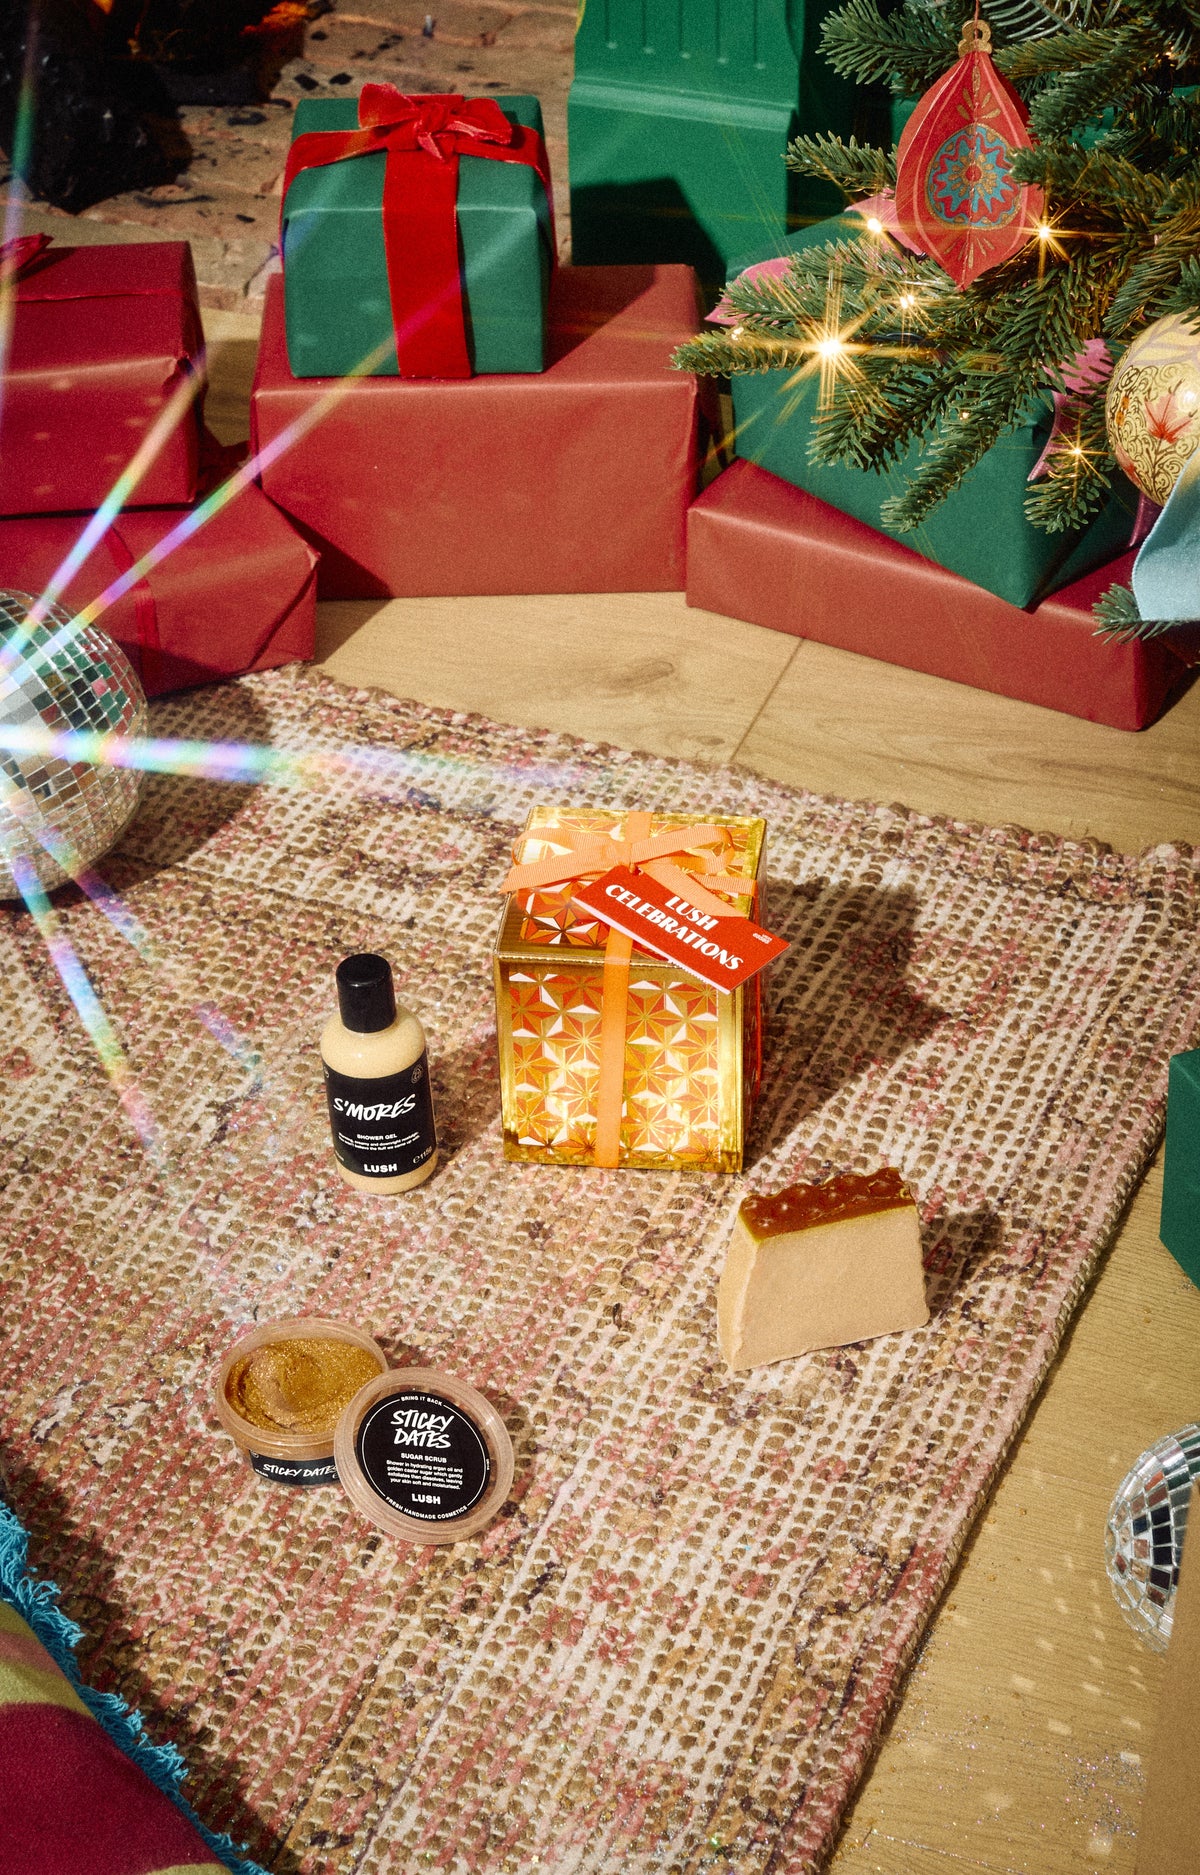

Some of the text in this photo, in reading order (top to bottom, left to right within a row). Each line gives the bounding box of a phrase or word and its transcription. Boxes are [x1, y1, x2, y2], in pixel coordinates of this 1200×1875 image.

[664, 895, 719, 931] LUSH
[605, 884, 743, 970] CELEBRATIONS
[333, 1093, 416, 1121] S'MORES
[363, 1163, 398, 1173] LUSH
[426, 1397, 443, 1406] BACK
[391, 1409, 454, 1432] STICKY
[393, 1428, 451, 1449] DATES
[400, 1452, 447, 1464] SUGAR SCRUB
[263, 1463, 302, 1477] STICKY
[386, 1496, 468, 1519] FRESH HANDMADE COSMETICS
[411, 1493, 441, 1505] LUSH
